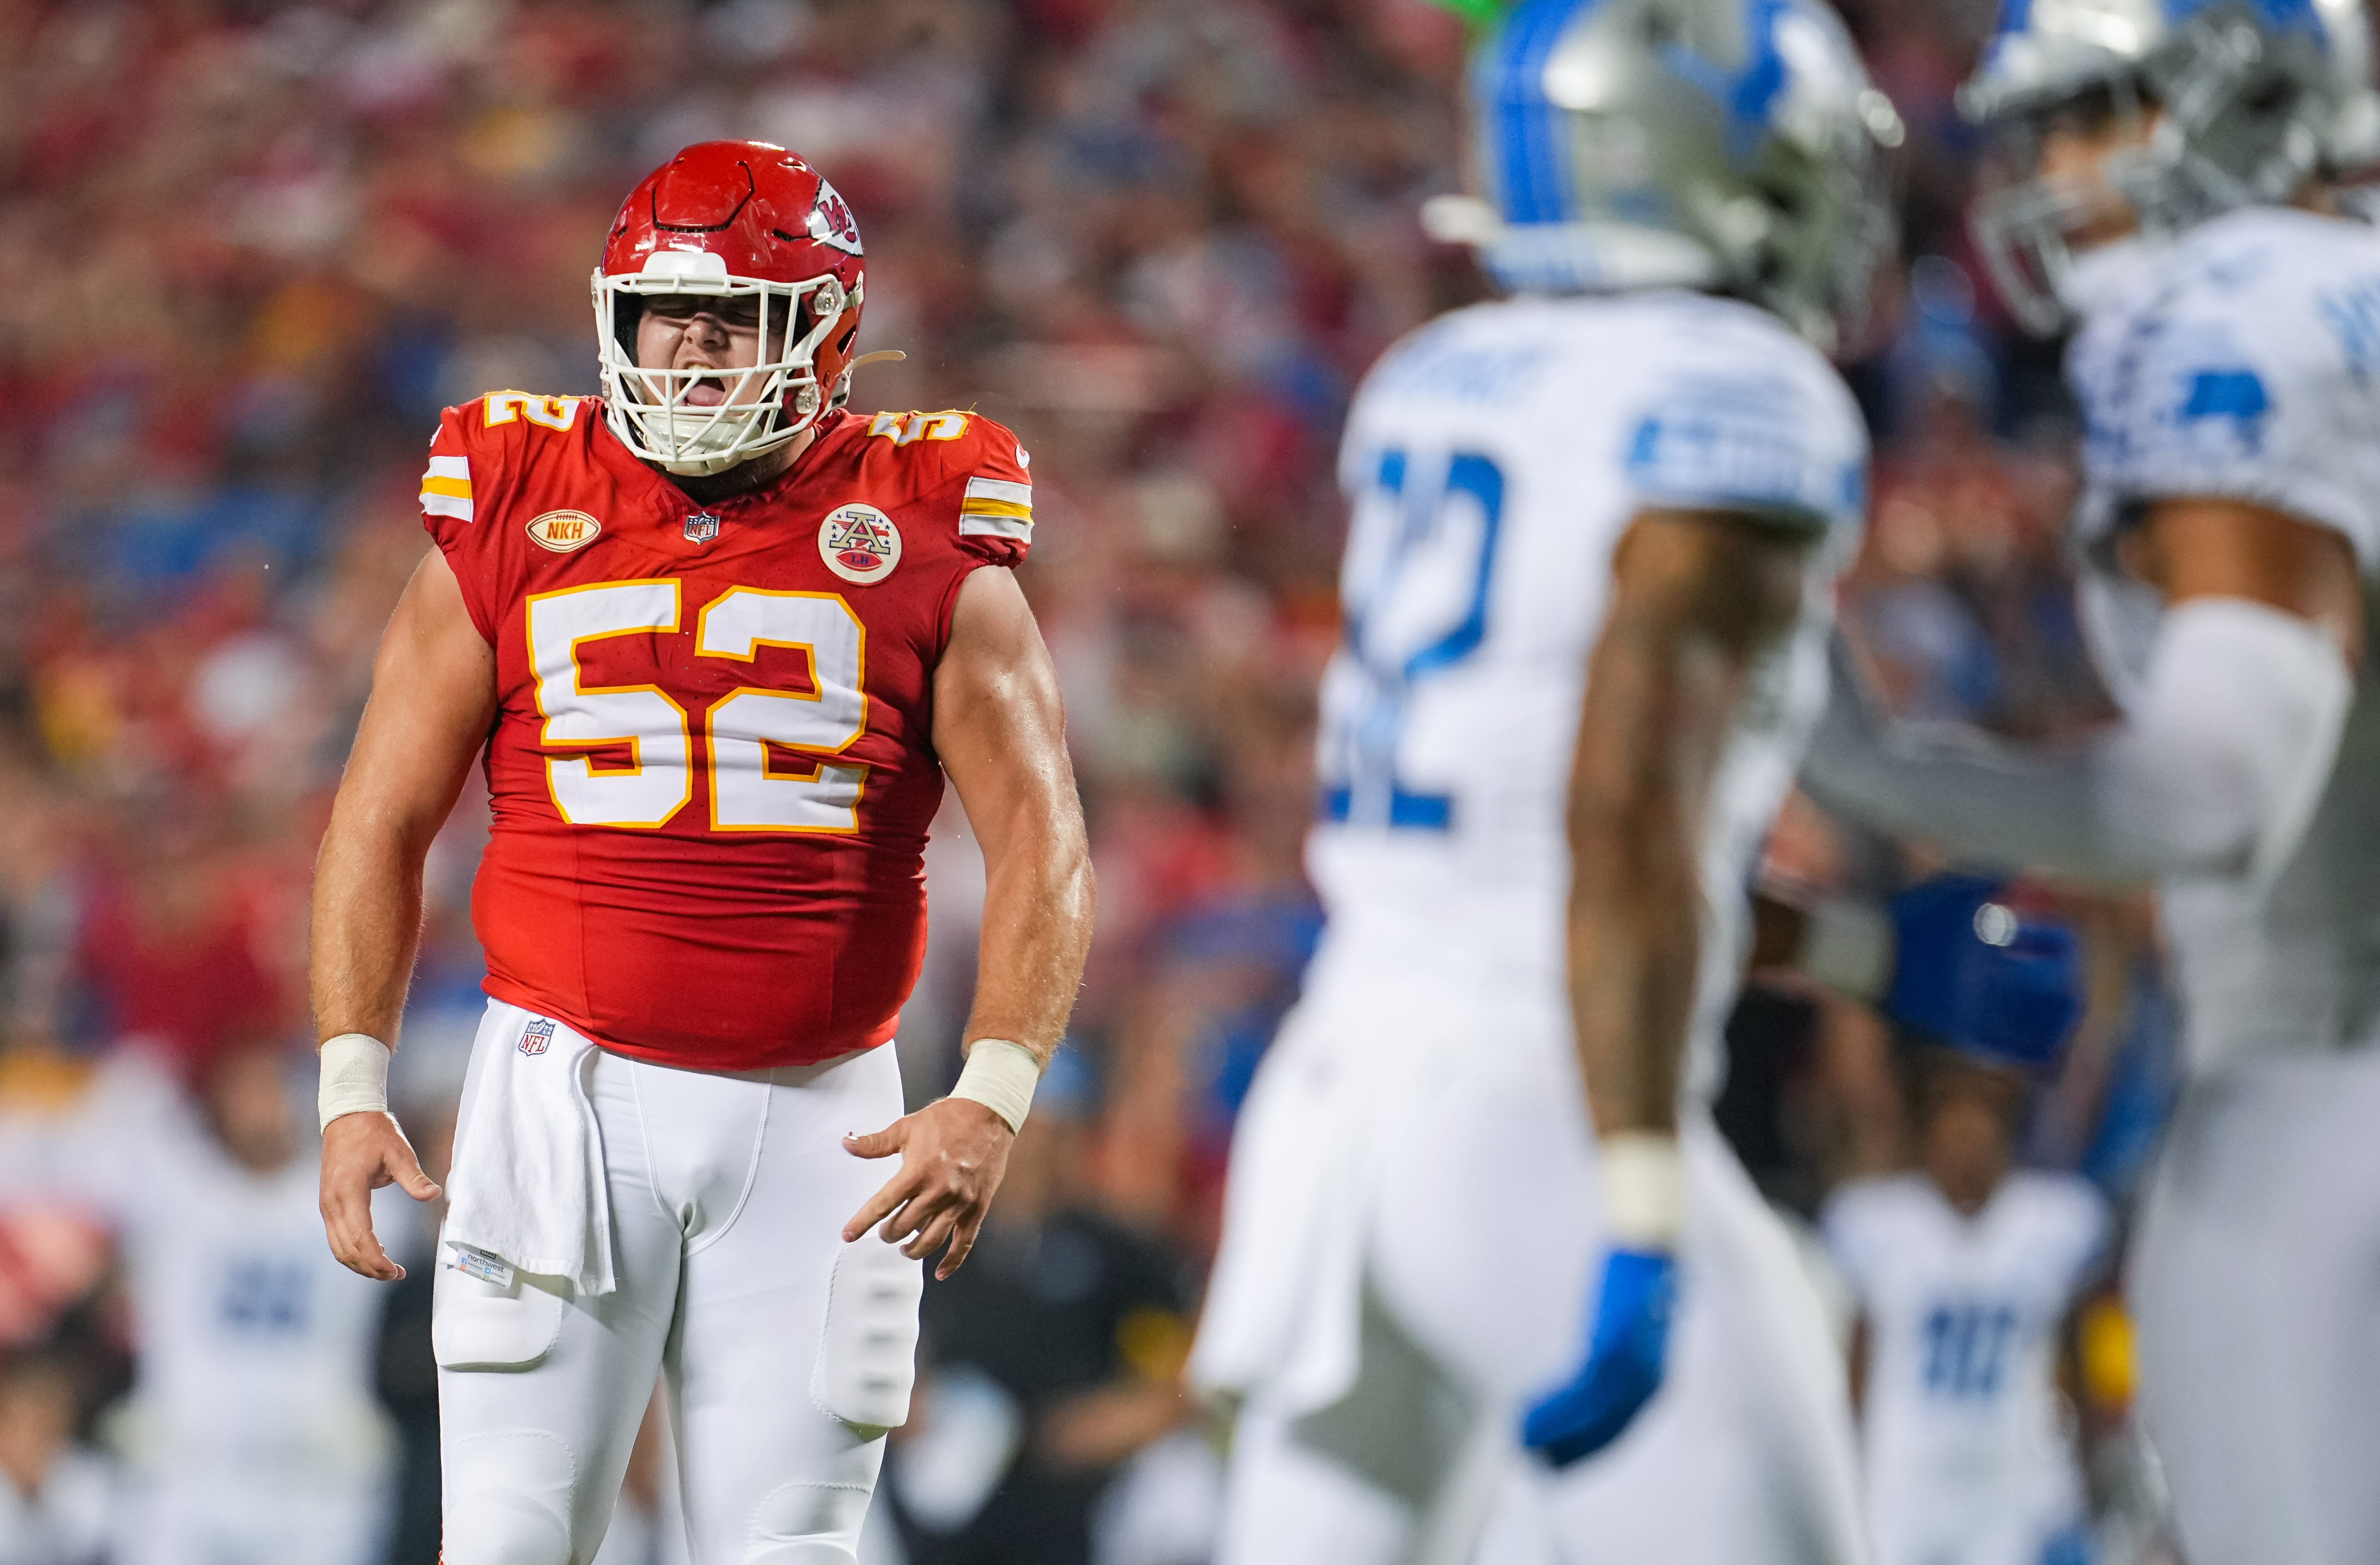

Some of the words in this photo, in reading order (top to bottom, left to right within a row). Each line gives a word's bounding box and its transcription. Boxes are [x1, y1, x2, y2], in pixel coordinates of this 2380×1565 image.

[547, 521, 585, 540] NKH
[690, 525, 712, 537] NFL
[526, 578, 869, 834] 52
[521, 1034, 545, 1053] NFL
[468, 1253, 504, 1273] northwest
